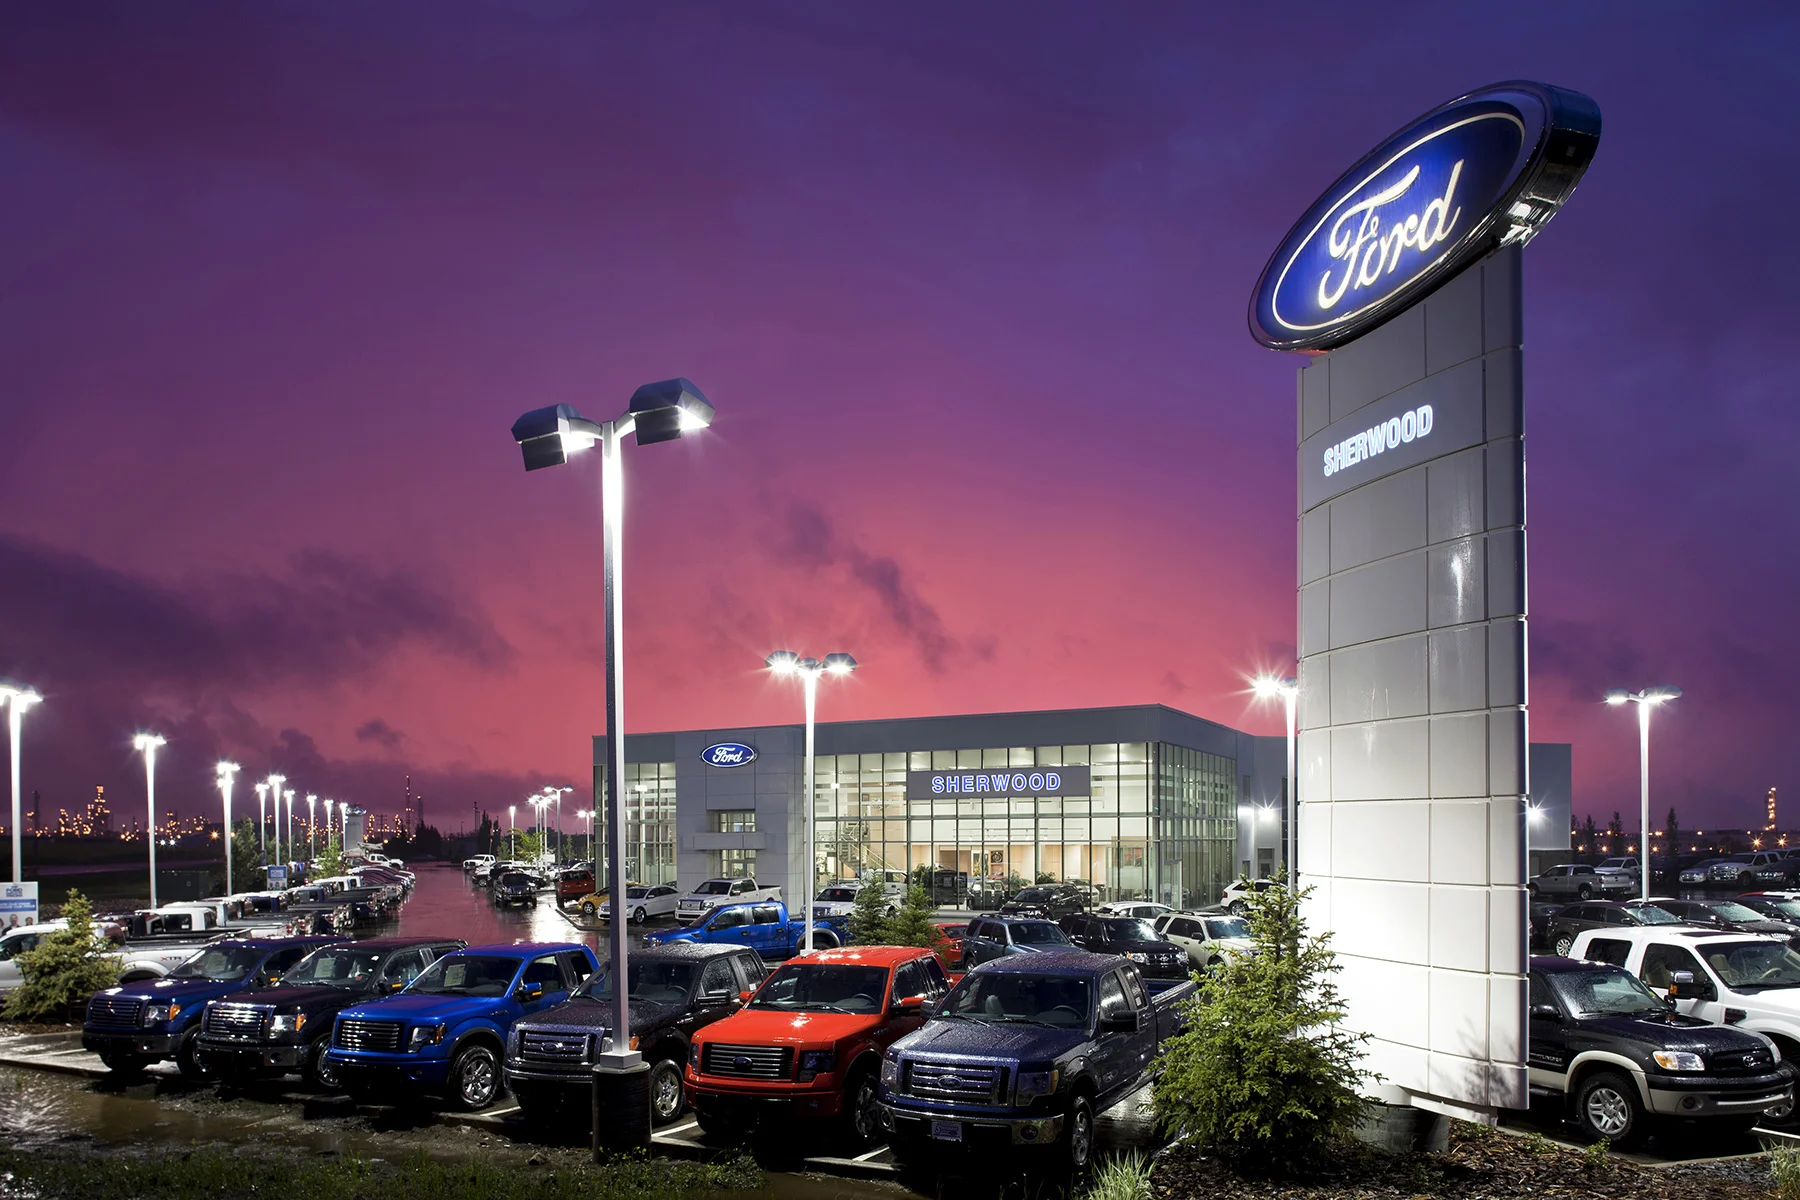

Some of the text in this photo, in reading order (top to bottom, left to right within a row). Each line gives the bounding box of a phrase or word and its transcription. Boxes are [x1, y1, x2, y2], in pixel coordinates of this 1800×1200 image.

[1318, 158, 1464, 309] Ford
[1323, 404, 1434, 477] SHERWOOD
[712, 746, 743, 763] Ford
[931, 772, 1062, 794] SHERWOOD
